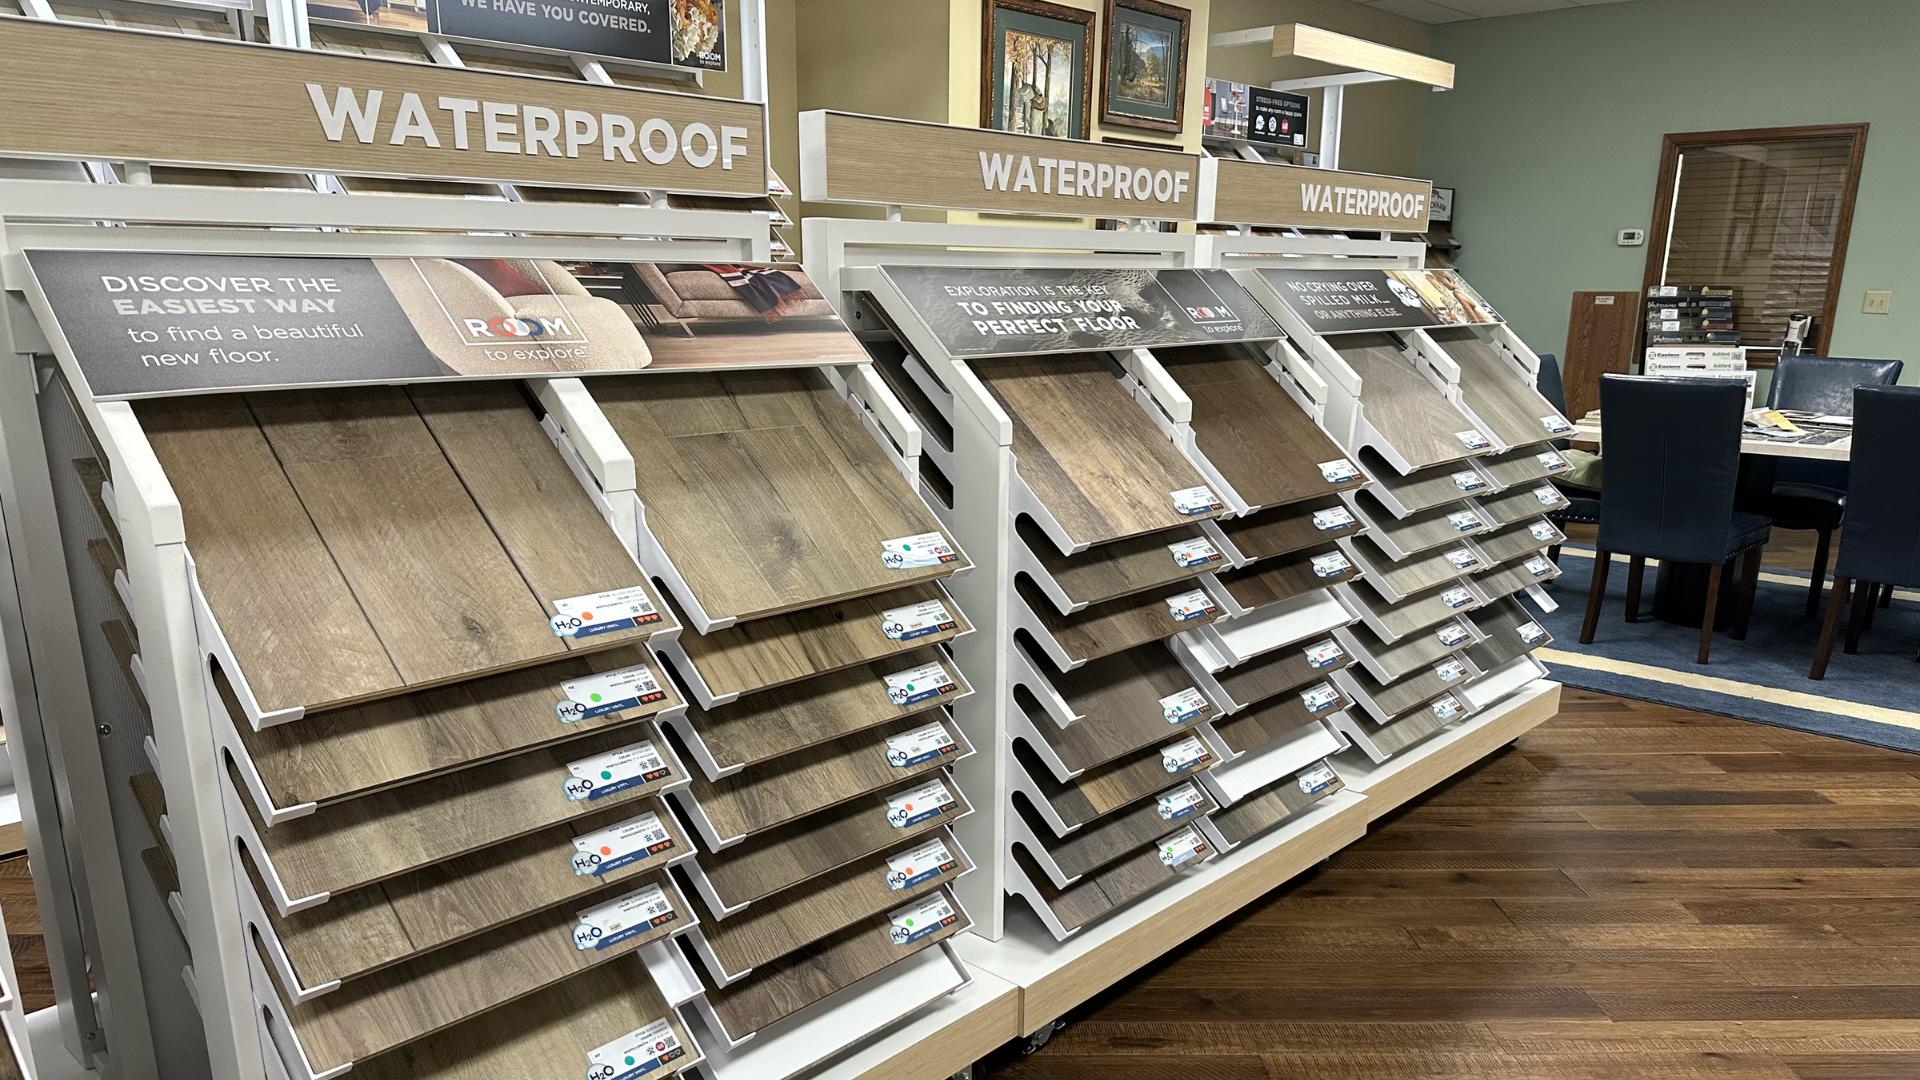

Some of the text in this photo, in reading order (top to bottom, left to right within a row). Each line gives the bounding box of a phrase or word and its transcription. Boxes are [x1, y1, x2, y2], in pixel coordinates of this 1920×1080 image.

[568, 0, 651, 15] EMPORARY,
[493, 0, 537, 17] HAVE
[541, 4, 574, 21] YOU
[578, 10, 651, 34] COVERED.
[699, 51, 721, 61] ROOM
[305, 83, 748, 170] WATERPROOF
[978, 151, 1190, 203] WATERPROOF
[1300, 183, 1425, 219] WATERPROOF
[101, 275, 342, 293] DISCOVER THE
[944, 285, 1109, 297] EXPLORATION IS THE KEY
[1286, 281, 1378, 293] NO CRYING OVER
[112, 298, 336, 315] EASIEST WAY
[957, 299, 1128, 316] TO FINDING YOUR
[1299, 295, 1350, 306] SPILLED
[1313, 307, 1402, 320] OR ANYTHING ELSE.
[971, 315, 1142, 336] PERFECT FLOOR
[1202, 325, 1214, 333] to
[127, 323, 364, 343] to find a beautiful
[141, 348, 280, 367] new floor.
[484, 348, 508, 361] to
[884, 554, 904, 564] H2O
[555, 618, 582, 630] H2O
[885, 623, 904, 634] H2O
[890, 688, 908, 700] H2O
[559, 702, 587, 716] H2O
[890, 751, 908, 762] H2O
[567, 779, 594, 794] H2O
[890, 809, 908, 822] H2O
[574, 854, 602, 868] H2O
[889, 872, 906, 884] H2O
[576, 926, 602, 942] H2O
[892, 928, 910, 940] H2O
[590, 1065, 614, 1080] H2O
